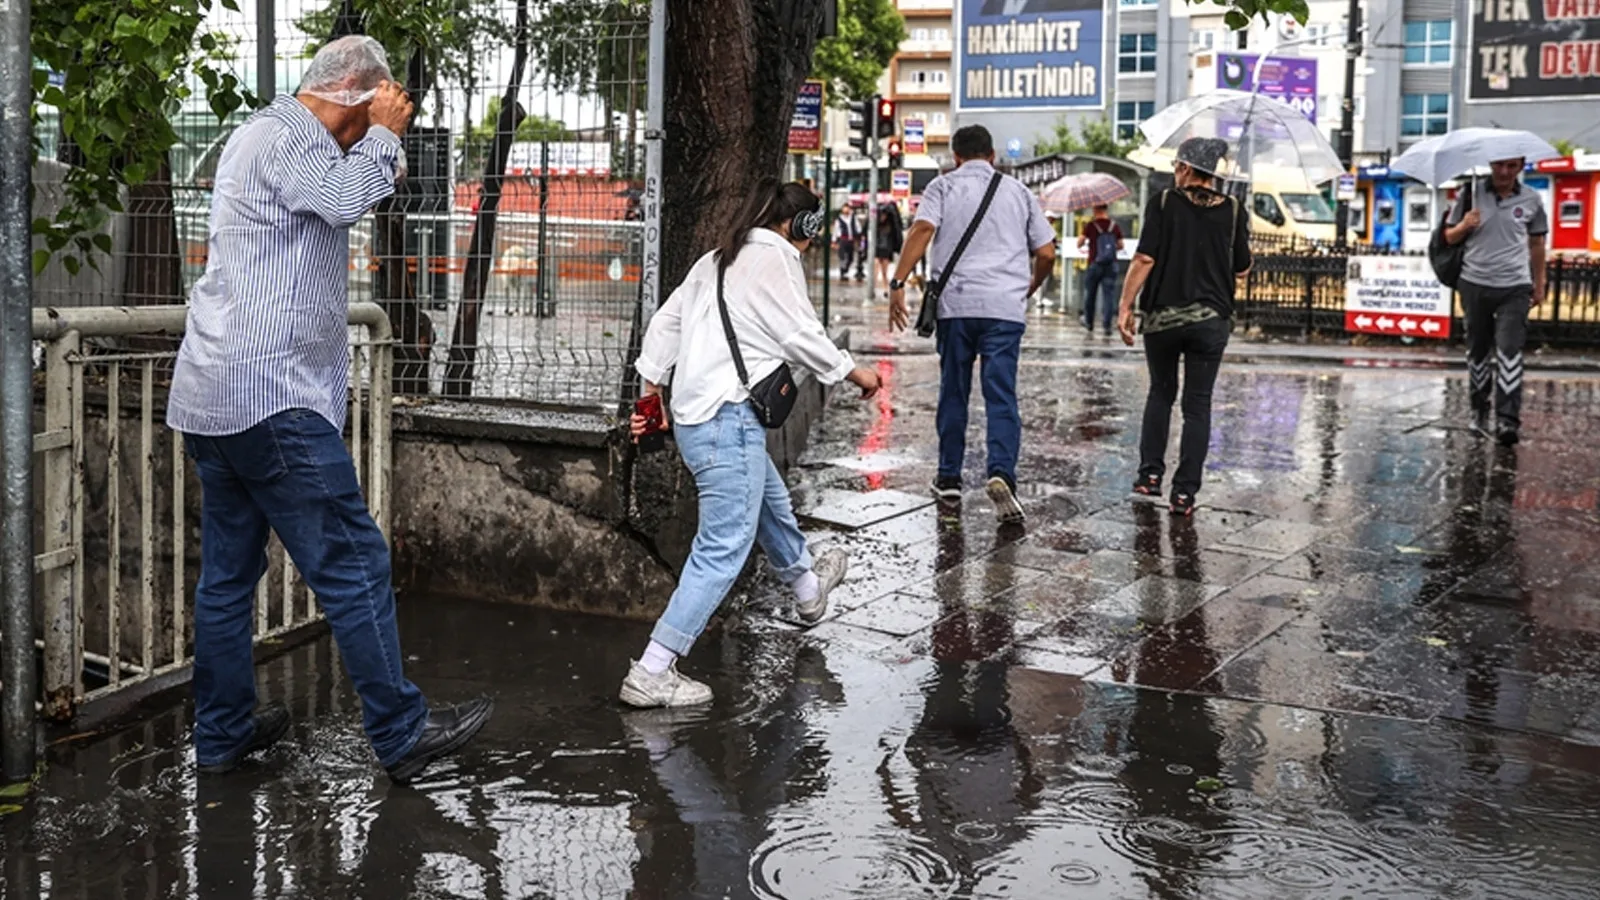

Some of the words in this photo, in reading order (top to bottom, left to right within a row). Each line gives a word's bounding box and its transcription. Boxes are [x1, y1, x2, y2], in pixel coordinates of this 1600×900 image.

[967, 17, 1082, 54] HAKİMİYET
[966, 60, 1096, 99] MİLLETİNDİR
[1479, 44, 1528, 79] TEK
